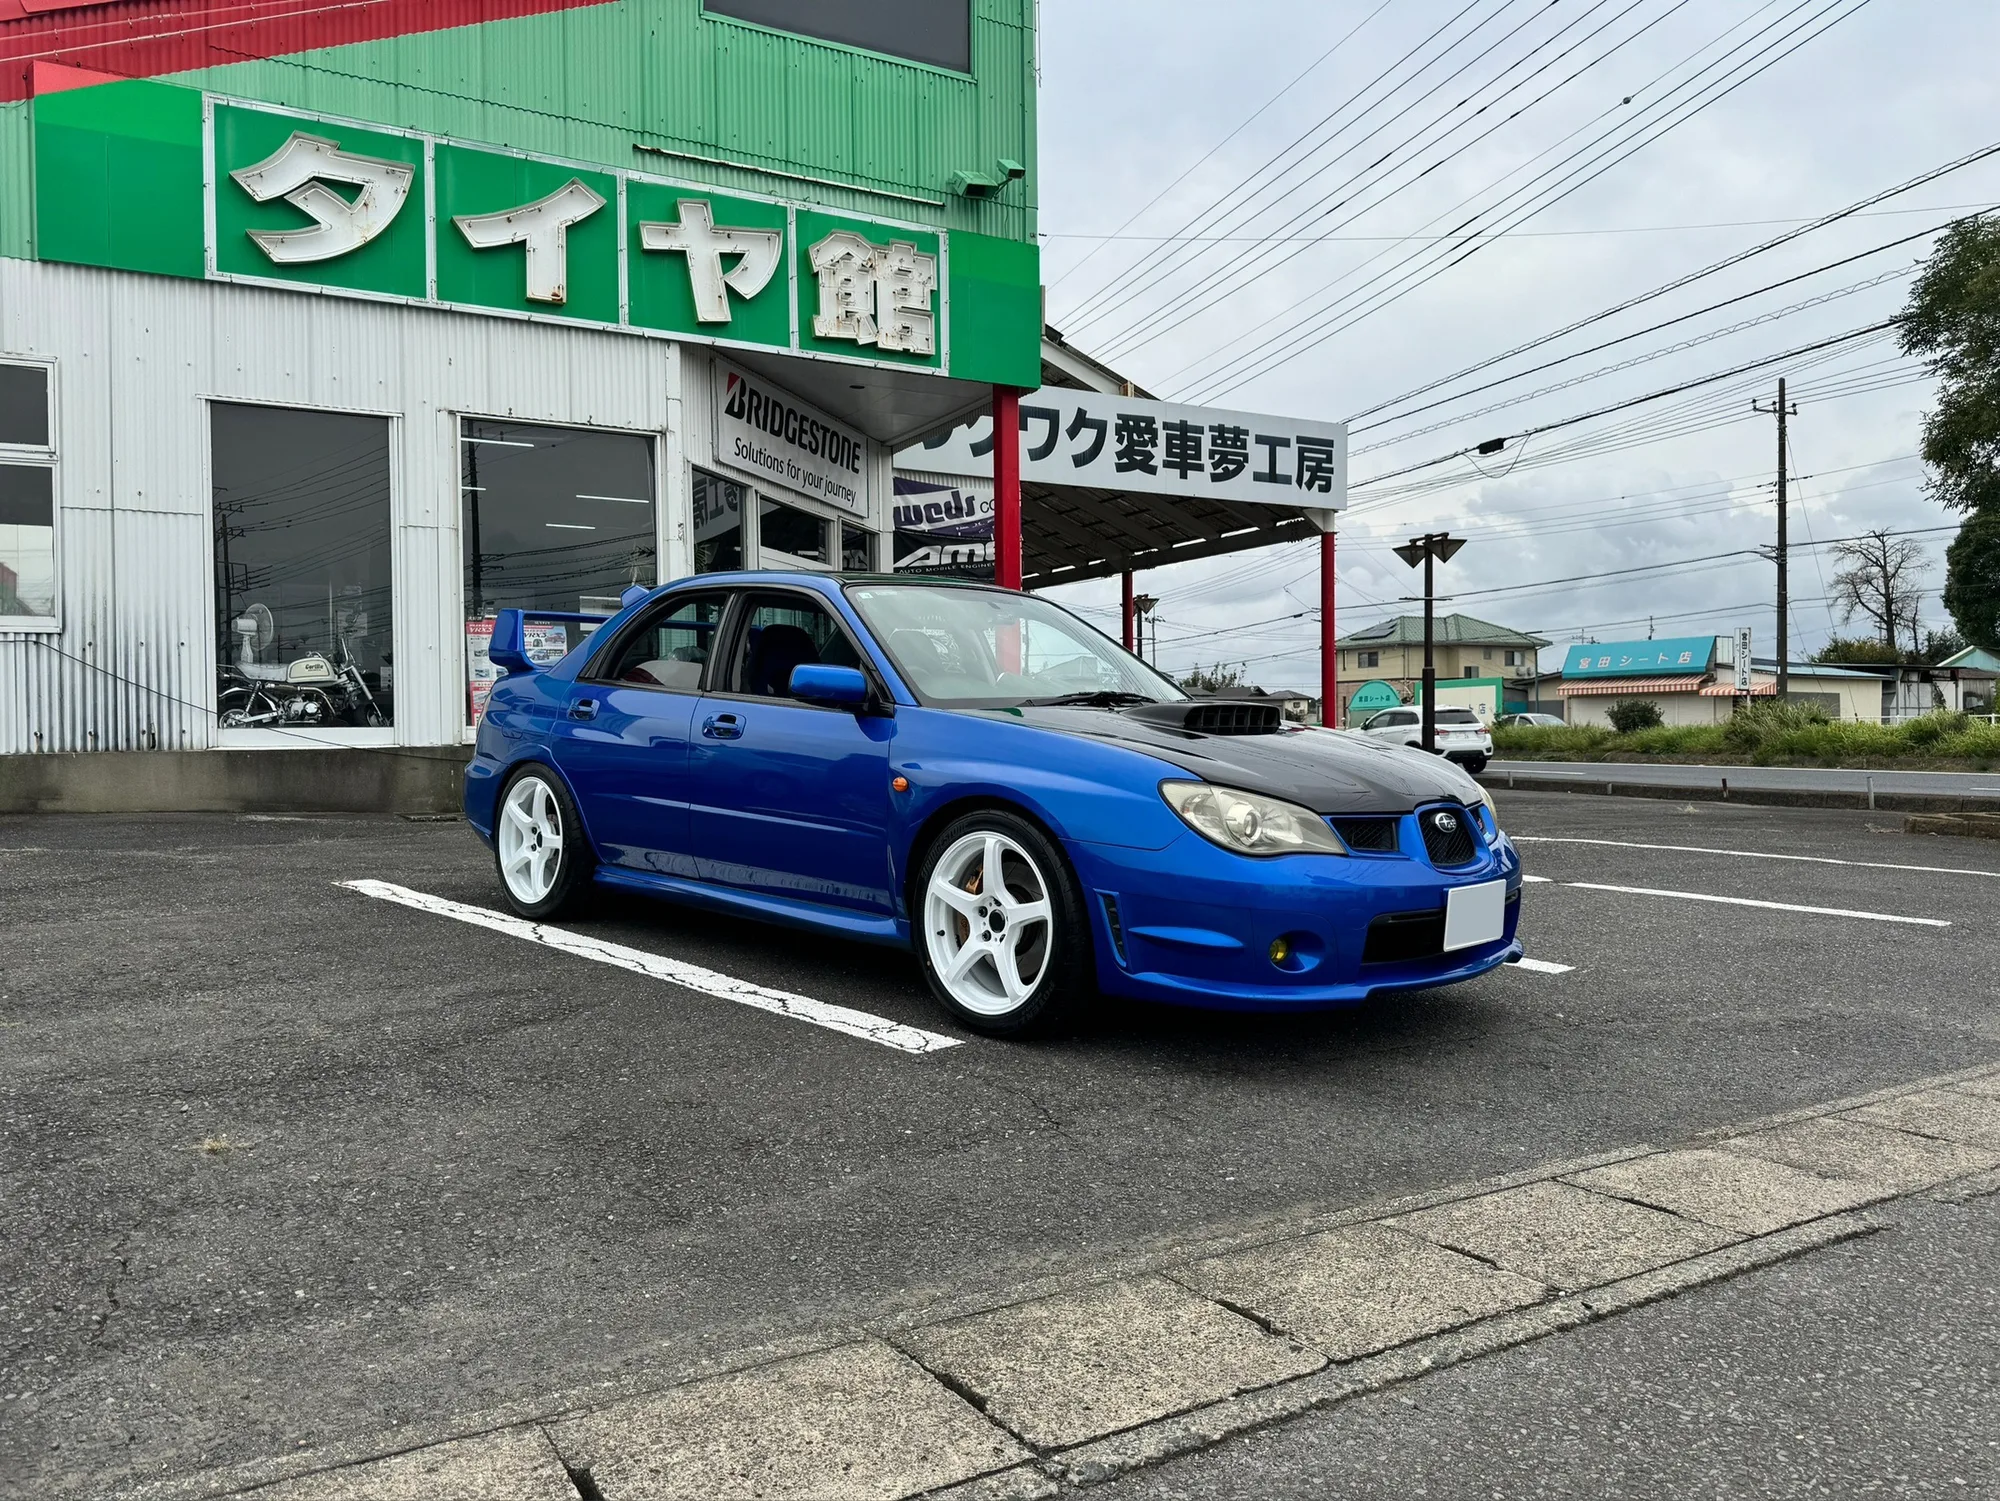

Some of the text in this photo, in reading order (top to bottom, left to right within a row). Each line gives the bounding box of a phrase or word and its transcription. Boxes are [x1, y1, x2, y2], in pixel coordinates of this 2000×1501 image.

[229, 129, 938, 356] タイヤ館
[724, 371, 861, 475] BRIDGESTONE
[734, 437, 857, 508] Solutions for your journey
[925, 564, 957, 573] MOBILE
[1578, 651, 1693, 669] 宮田シート店
